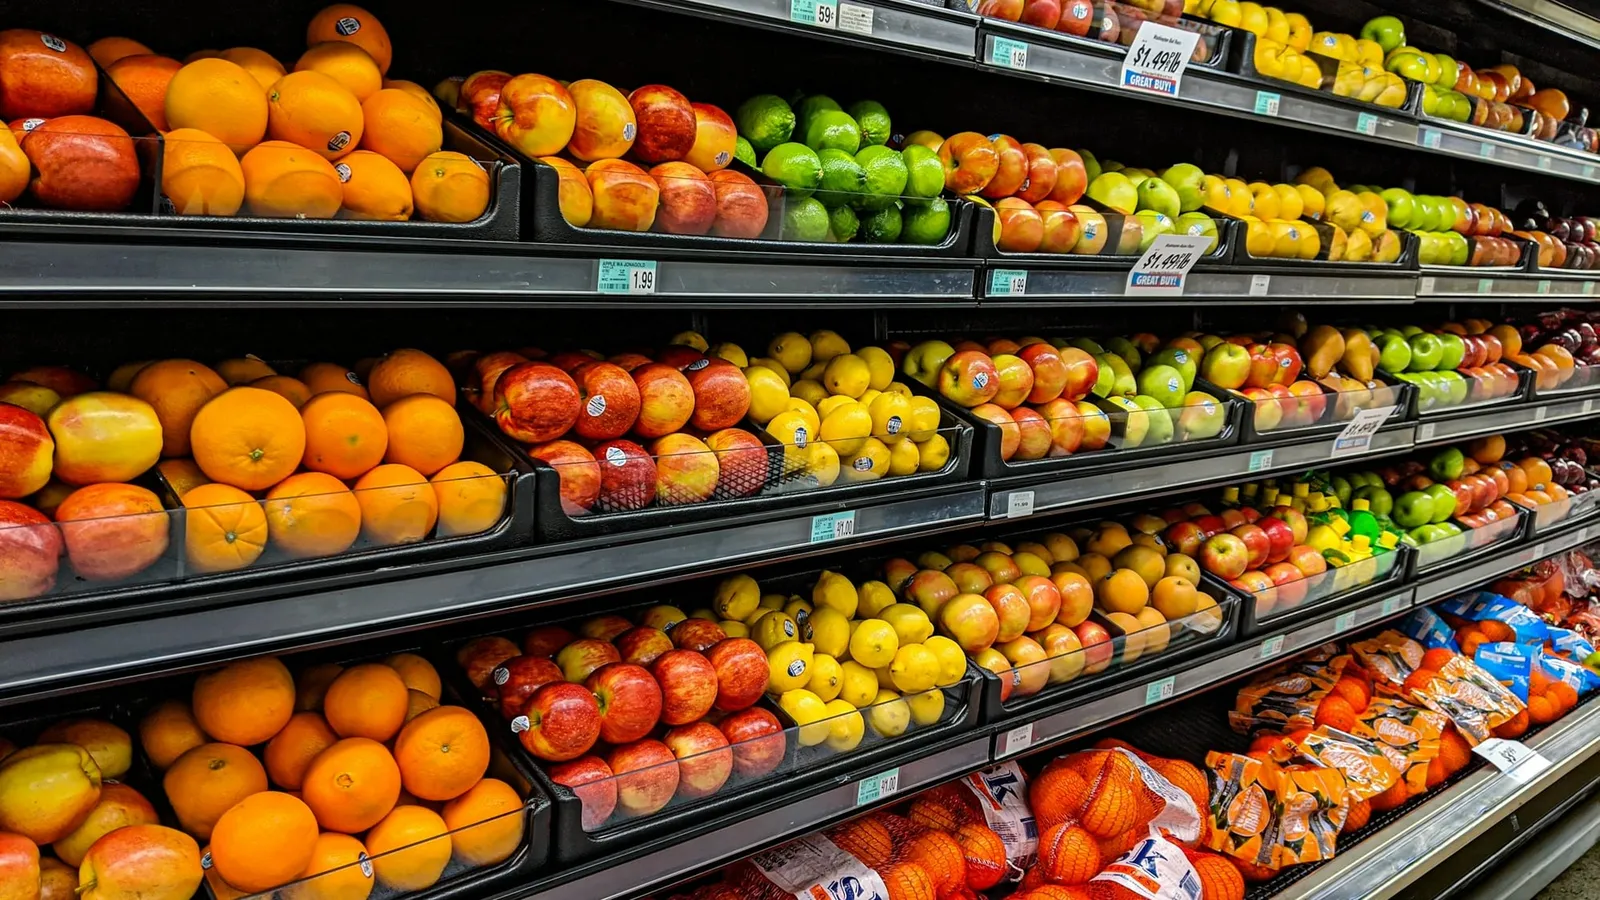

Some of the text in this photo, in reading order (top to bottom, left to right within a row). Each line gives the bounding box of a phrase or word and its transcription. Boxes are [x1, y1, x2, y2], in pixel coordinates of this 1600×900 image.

[819, 5, 834, 23] 59¢
[1013, 50, 1025, 67] 1.99
[1130, 74, 1153, 89] GREAT
[1154, 80, 1172, 92] BUY!
[634, 271, 653, 289] 1.99
[1012, 278, 1025, 293] 1.99
[1136, 275, 1177, 286] GREAT BUY!
